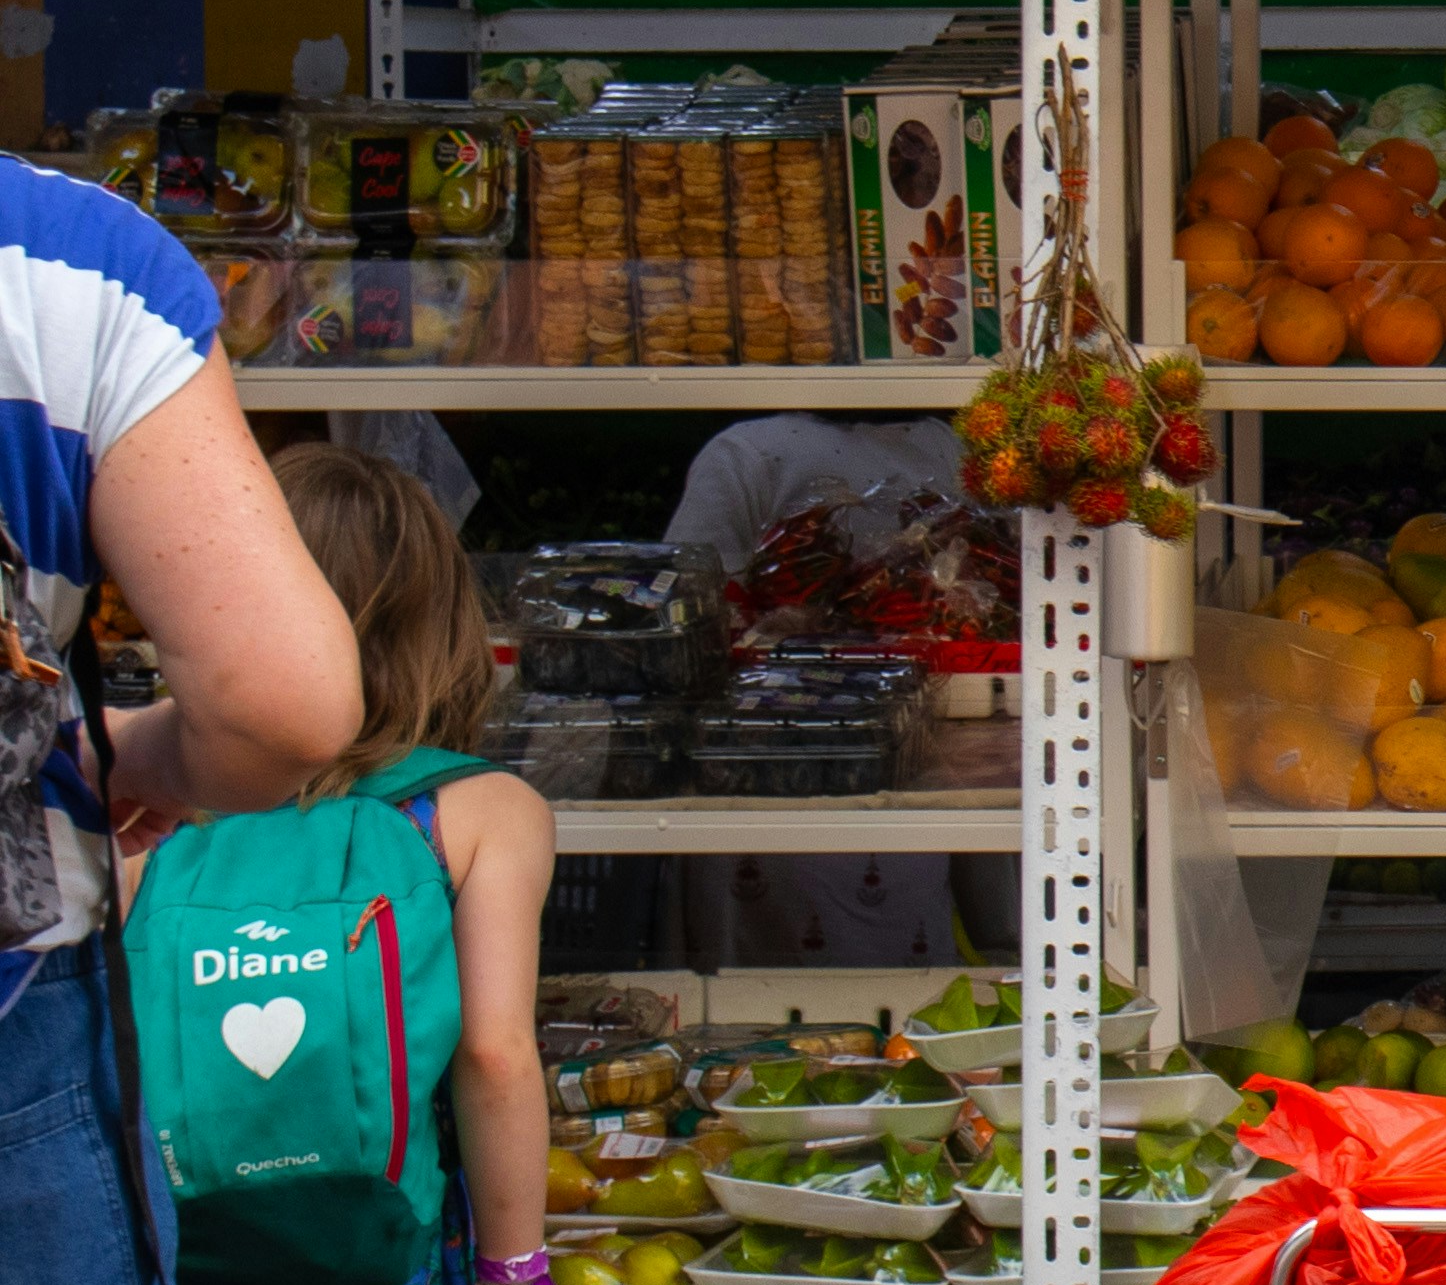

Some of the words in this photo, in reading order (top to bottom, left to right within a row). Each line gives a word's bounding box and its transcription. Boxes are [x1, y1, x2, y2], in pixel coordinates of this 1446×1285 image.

[358, 147, 402, 174] Cape
[362, 175, 403, 199] Cool
[859, 209, 885, 305] ELAMIN
[971, 211, 996, 308] ELAMIN
[193, 947, 328, 986] Diane
[235, 1152, 320, 1175] Quechua
